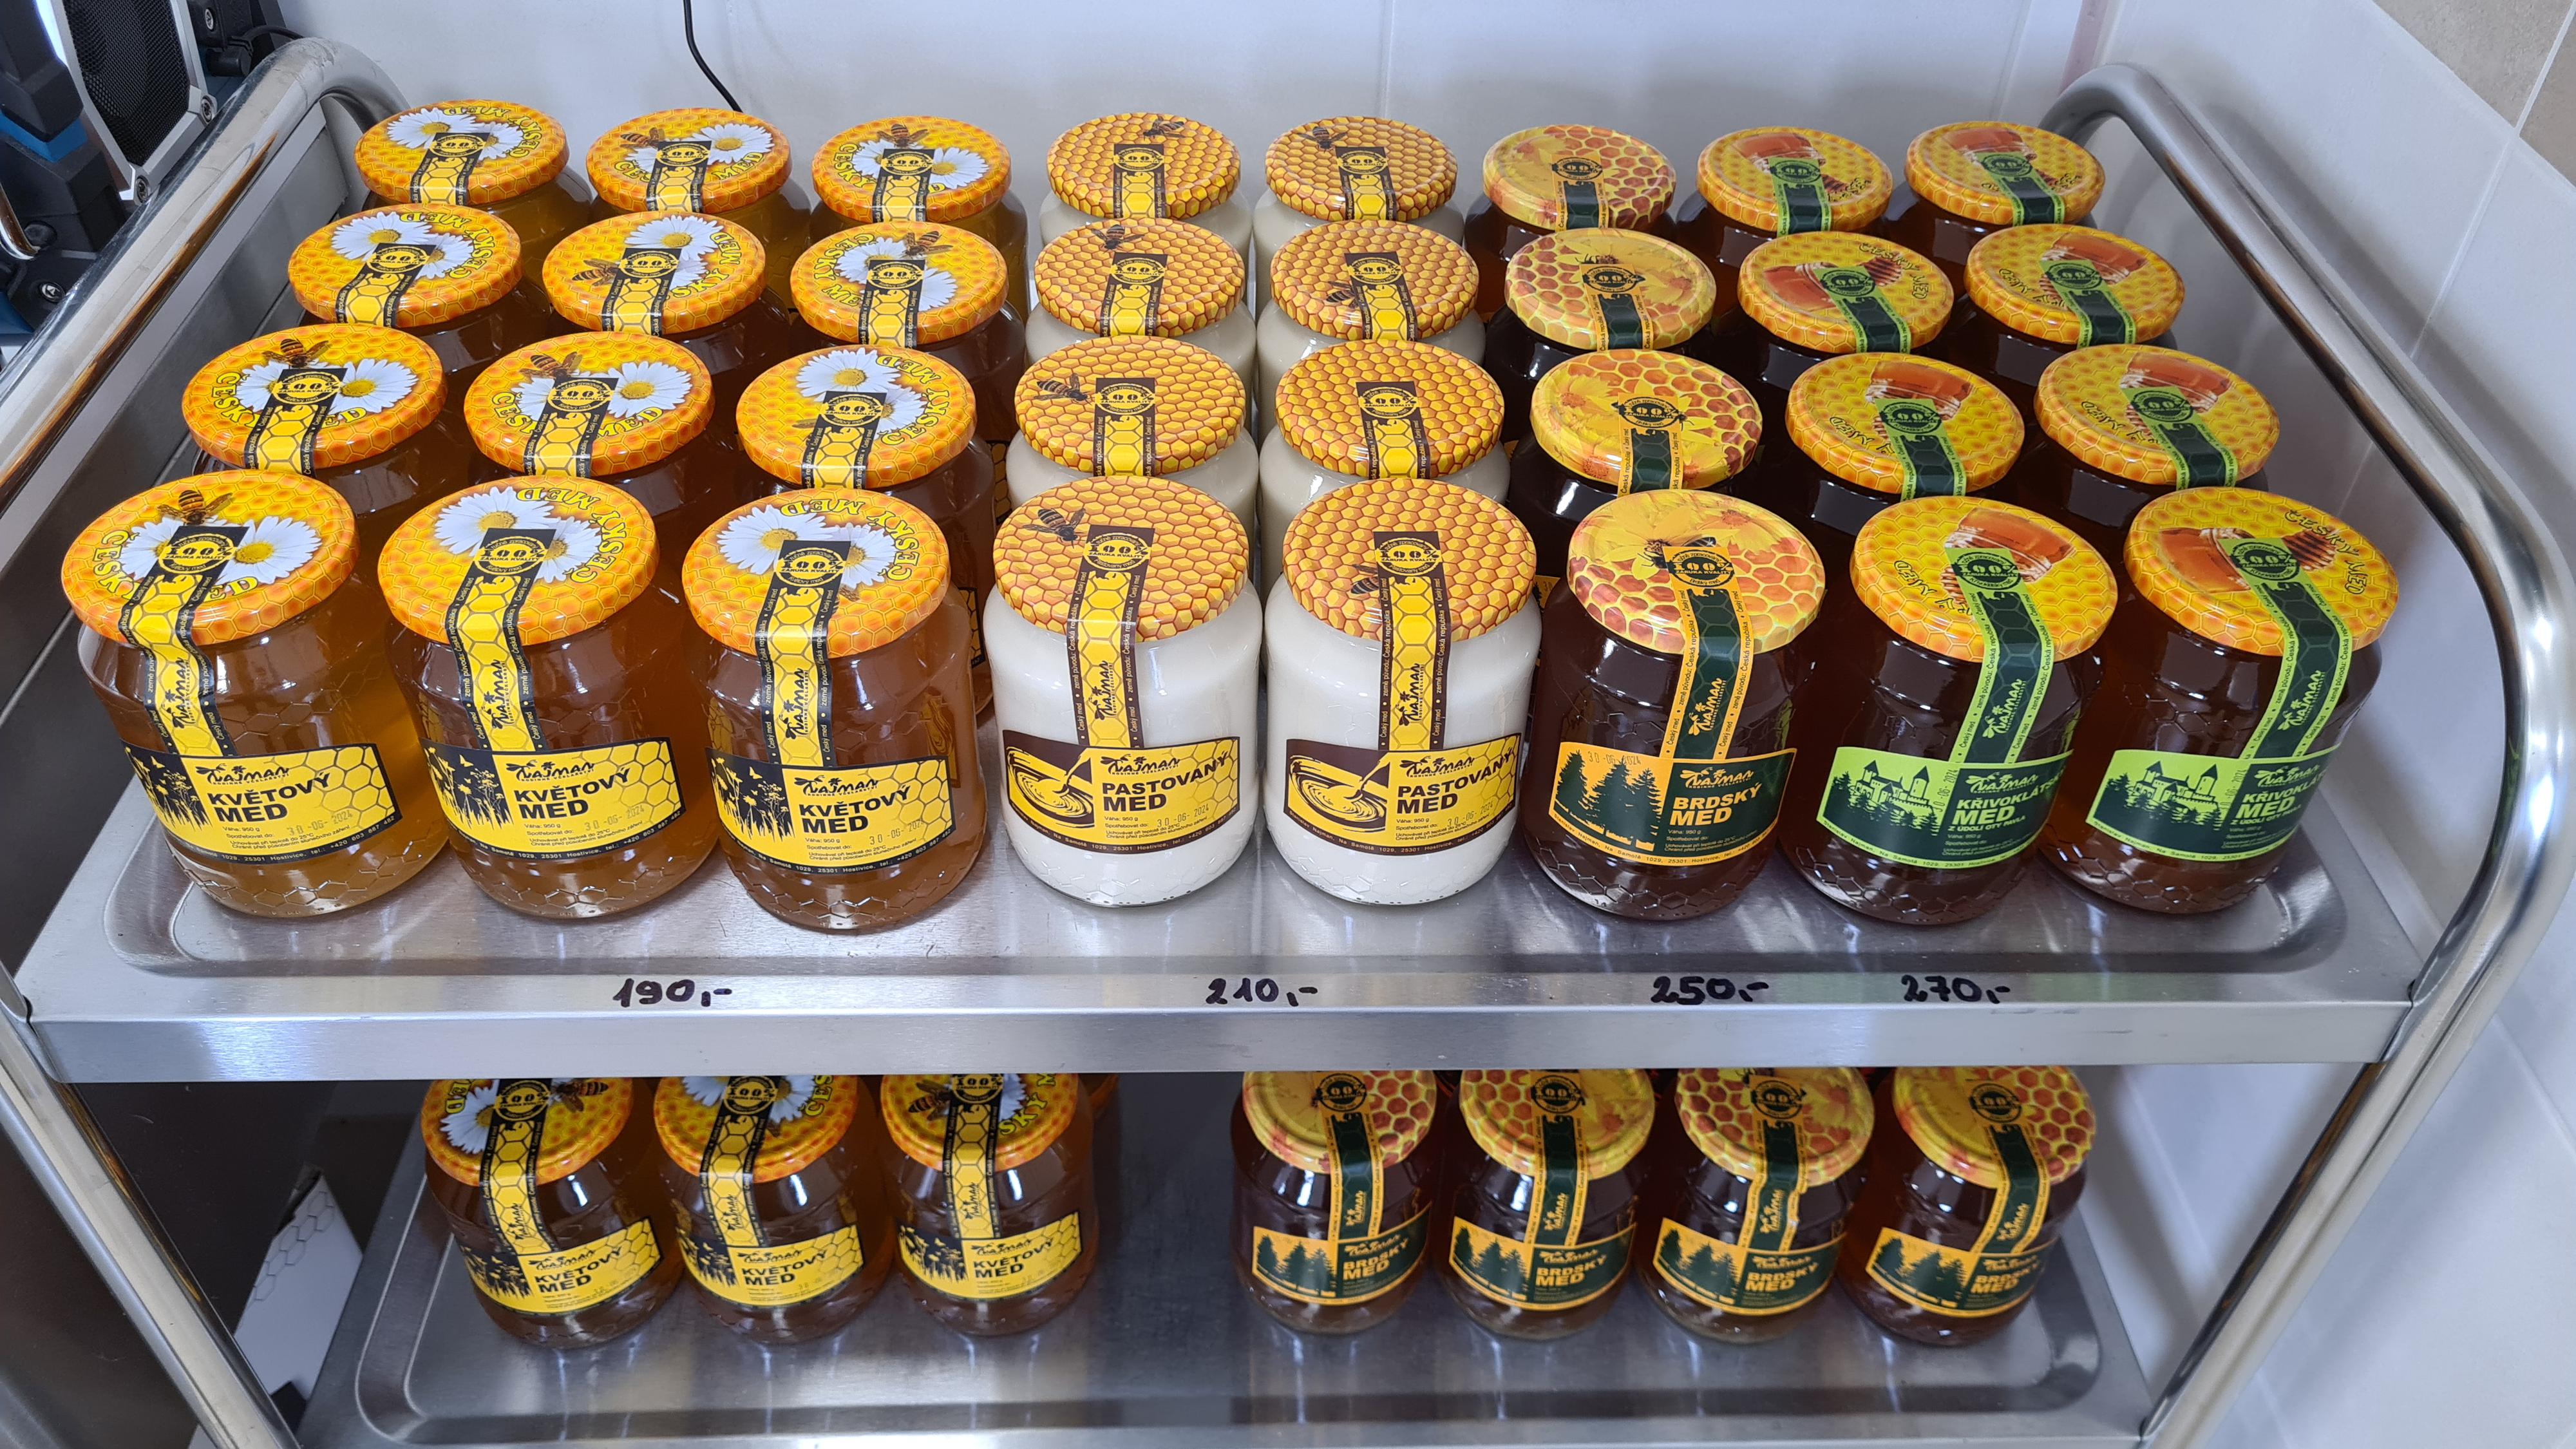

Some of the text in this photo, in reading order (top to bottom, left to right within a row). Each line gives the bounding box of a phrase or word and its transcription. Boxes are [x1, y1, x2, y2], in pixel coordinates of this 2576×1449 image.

[444, 106, 508, 118] MED
[613, 151, 764, 182] ČES MED
[400, 211, 468, 229] MED
[672, 231, 742, 298] SKÝ MED
[822, 284, 862, 309] ME
[876, 354, 941, 384] MED
[279, 381, 339, 390] 100%
[821, 403, 880, 413] 100%
[1094, 393, 1154, 402] 100%
[325, 407, 366, 428] ED
[516, 488, 628, 583] ČESKÝ MED
[781, 498, 919, 580] ČESKÝ MED
[165, 546, 235, 557] 100%
[480, 549, 545, 560] 100%
[1089, 545, 1149, 556] 100%
[1380, 550, 1440, 559] 100%
[783, 560, 844, 571] 100%
[1674, 561, 1734, 571] 100%
[207, 576, 259, 601] ED
[1102, 749, 1229, 795] PASTOVANÝ
[1397, 746, 1514, 799] PASTOVANÝ
[207, 772, 330, 806] KVĚTOVÝ
[513, 767, 630, 802] KVĚTOVÝ
[799, 786, 911, 817] KVĚTOVÝ
[1103, 793, 1167, 813] MED
[1396, 793, 1459, 815] MED
[1672, 781, 1763, 810] BRDSKÝ
[214, 804, 288, 822] MED
[518, 799, 589, 819] MED
[1669, 808, 1732, 826] MED
[1951, 805, 2016, 826] MED
[2235, 797, 2295, 818] MED
[802, 815, 869, 835] MED
[954, 1077, 1002, 1086] 100%
[801, 1076, 833, 1117] ČES
[999, 1093, 1047, 1135] SKÝ
[742, 1247, 828, 1278] KVĚTOVÝ
[972, 1237, 1054, 1269] KVĚTOVÝ
[534, 1245, 621, 1284] KVĚTOVÝ
[976, 1262, 1025, 1279] MED
[1342, 1258, 1391, 1282] MED
[538, 1273, 592, 1294] MED
[744, 1271, 796, 1287] MED
[1535, 1268, 1585, 1288] MED
[1745, 1275, 1795, 1292] MED
[1969, 1278, 2019, 1294] MED
